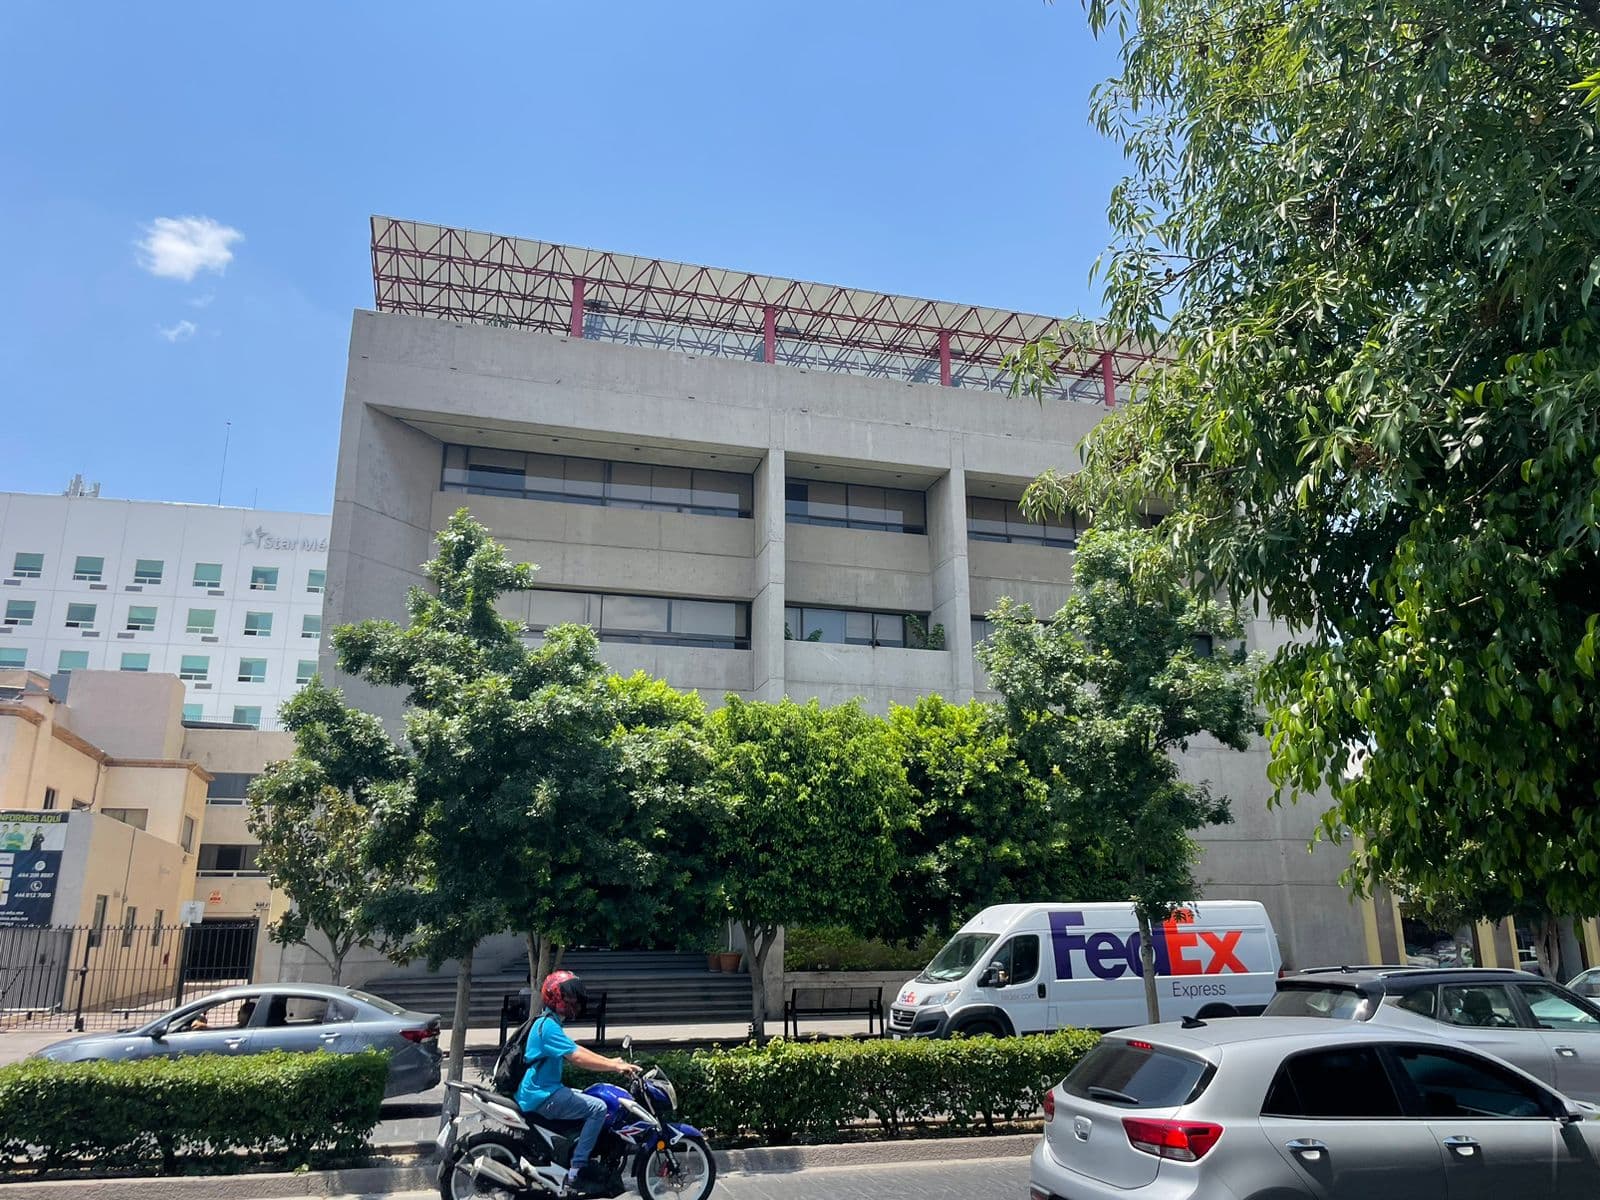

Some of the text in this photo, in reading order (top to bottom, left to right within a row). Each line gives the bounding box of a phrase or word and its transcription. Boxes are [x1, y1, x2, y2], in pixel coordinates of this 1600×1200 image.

[264, 536, 299, 551] Star
[1048, 908, 1249, 980] FedEx
[1172, 981, 1226, 999] Express
